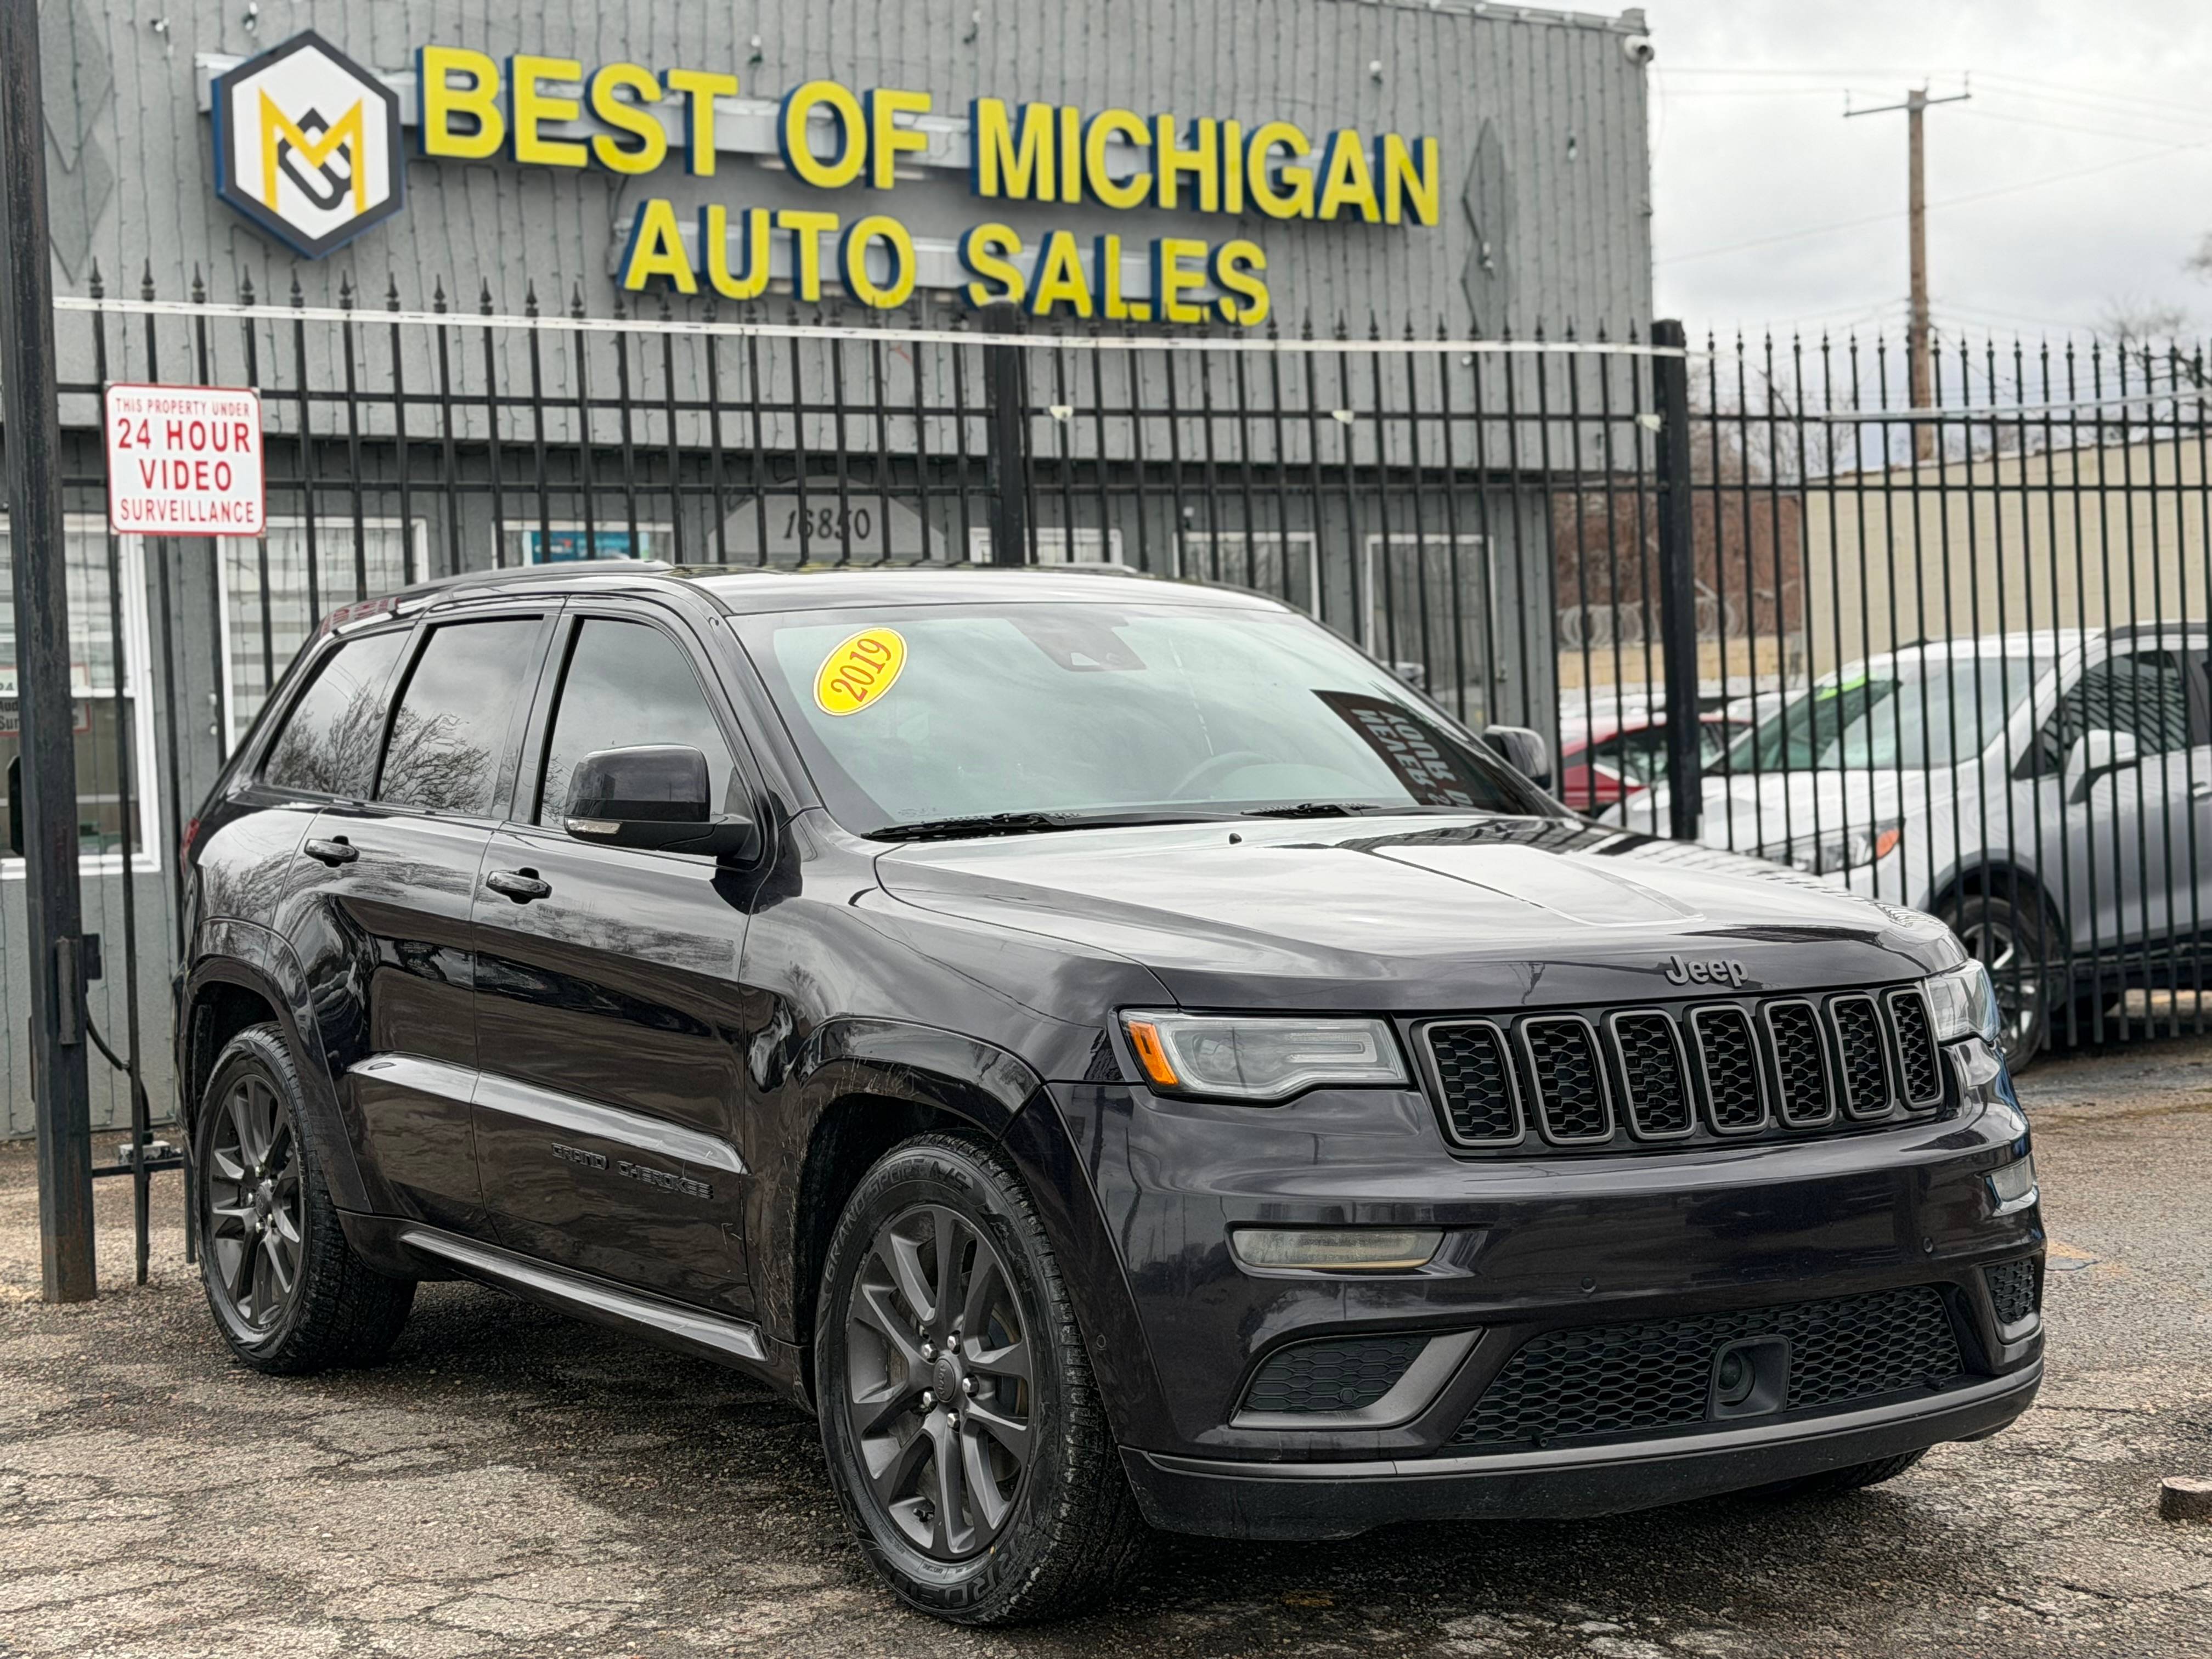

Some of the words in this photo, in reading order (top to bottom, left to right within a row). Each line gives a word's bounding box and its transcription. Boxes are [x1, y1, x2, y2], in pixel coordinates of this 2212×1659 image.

[417, 45, 739, 177] BEST
[778, 80, 932, 190] OF
[970, 97, 1440, 227] MICHIGAN
[620, 198, 916, 309] AUTO
[959, 223, 1271, 326] SALES
[116, 398, 142, 413] THIS
[148, 399, 207, 416] PROPERTY
[213, 402, 250, 417] UNDER
[117, 418, 151, 449] 24
[166, 420, 251, 453] HOUR
[139, 459, 232, 492] VIDEO
[120, 499, 254, 523] SURVEILLANCE
[830, 638, 891, 703] 2019
[1665, 955, 1748, 989] Jeep
[551, 1143, 609, 1170] GRAND
[617, 1160, 713, 1199] CHEROKEE
